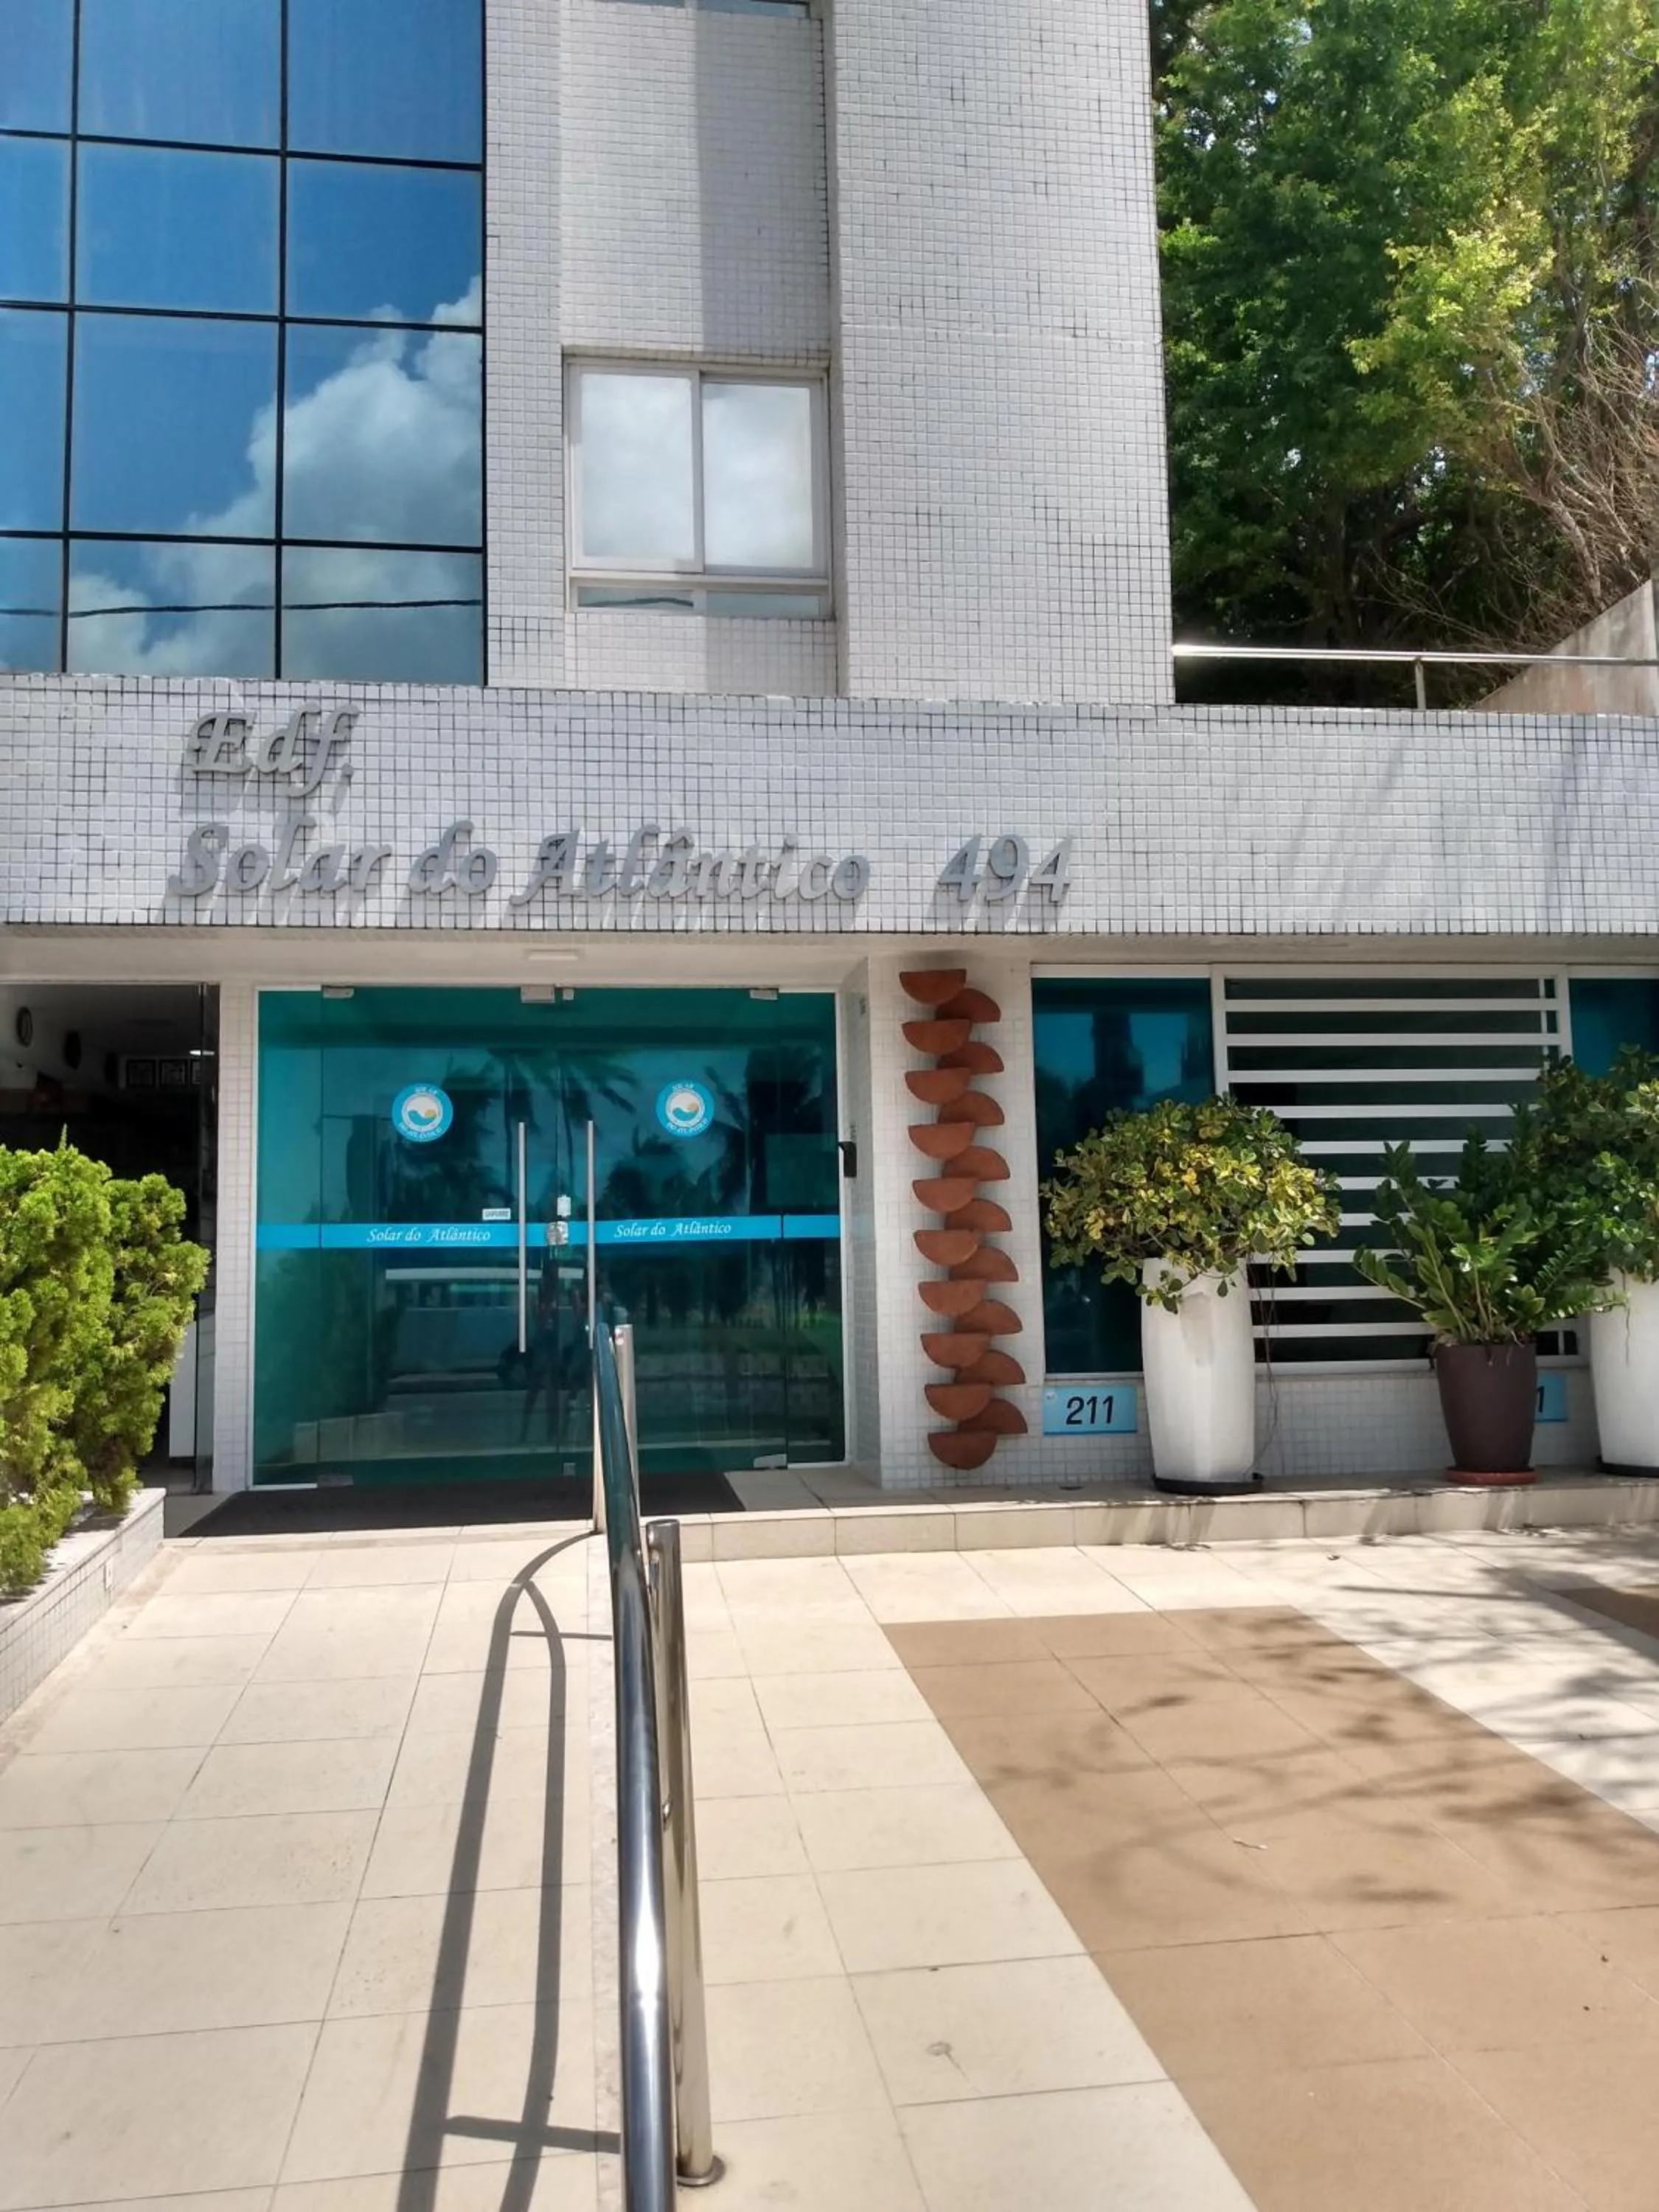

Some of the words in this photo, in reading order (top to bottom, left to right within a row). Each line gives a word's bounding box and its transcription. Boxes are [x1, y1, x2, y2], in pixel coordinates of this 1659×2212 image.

[167, 815, 392, 897] Solar
[407, 820, 497, 894] do
[510, 821, 870, 905] Atlântico
[937, 832, 1074, 902] 494
[366, 1227, 403, 1242] Solar
[405, 1227, 422, 1241] do
[426, 1226, 491, 1242] Atlântico
[613, 1222, 649, 1238] Solar
[650, 1222, 666, 1236] do
[671, 1221, 731, 1237] Atlântico
[1065, 1395, 1114, 1425] 211
